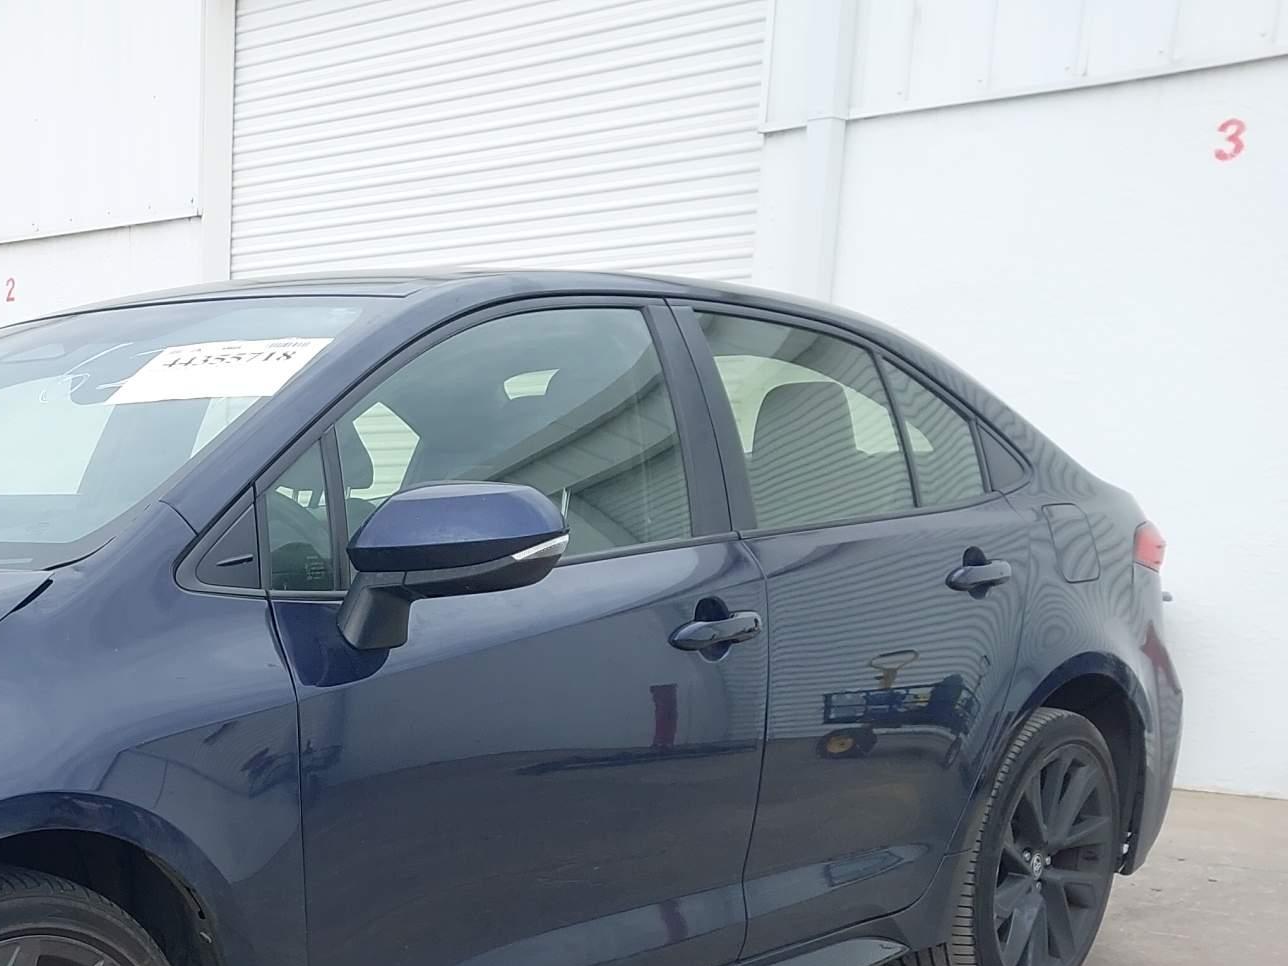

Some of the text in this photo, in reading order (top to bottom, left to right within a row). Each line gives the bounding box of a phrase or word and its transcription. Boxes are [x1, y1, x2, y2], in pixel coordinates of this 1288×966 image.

[1214, 117, 1247, 162] 3
[5, 277, 16, 302] 2
[162, 350, 298, 369] 44355718
